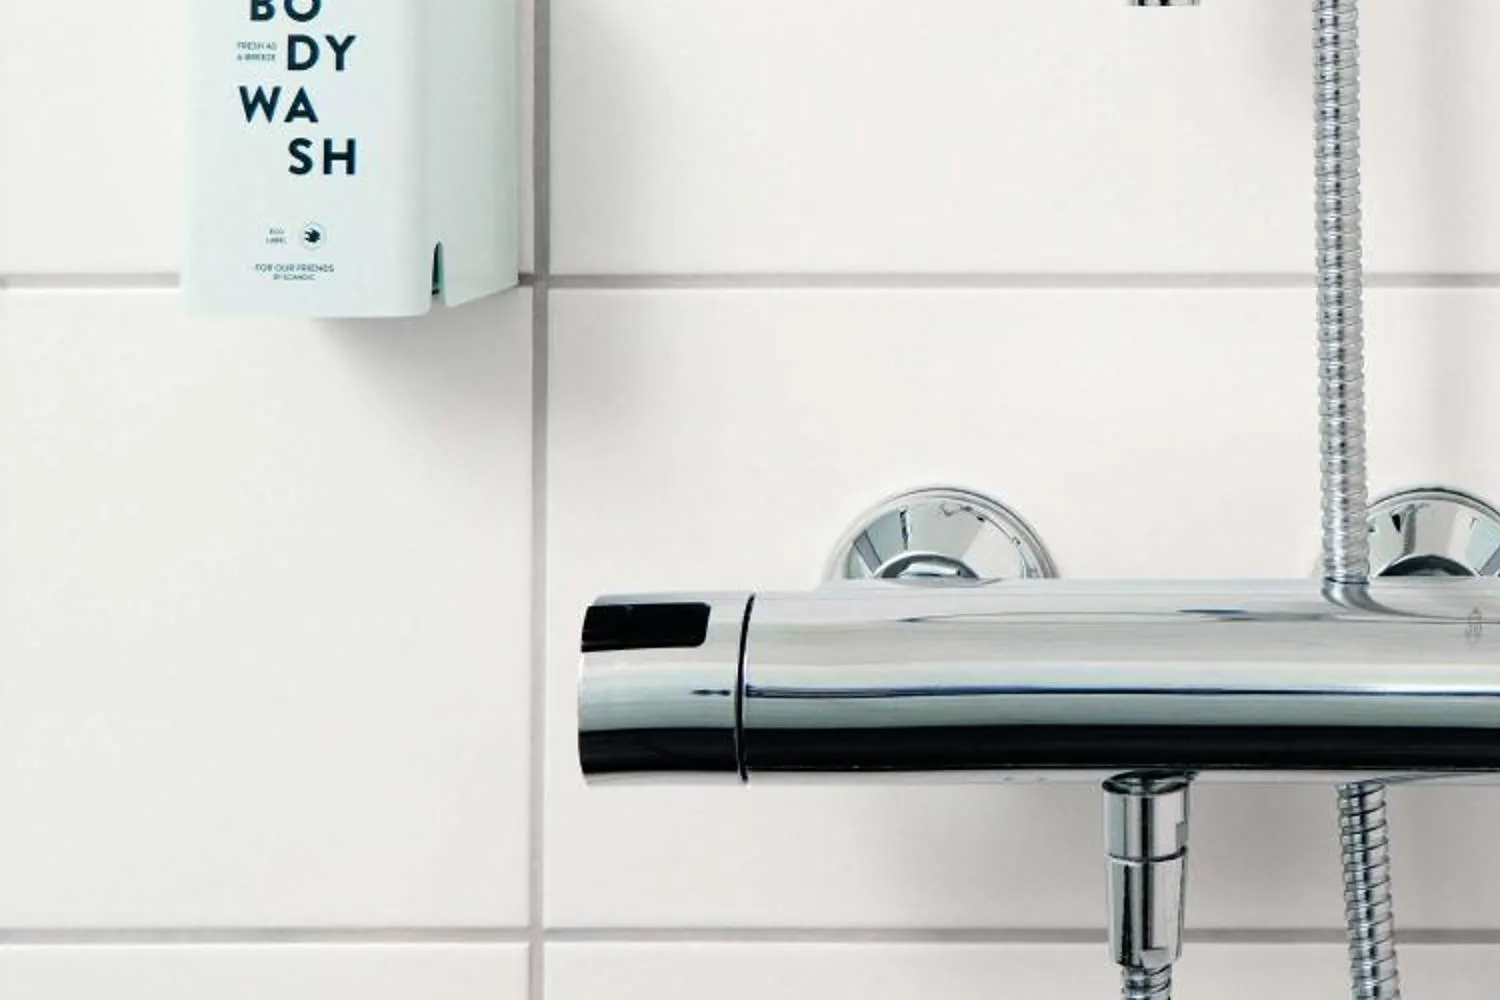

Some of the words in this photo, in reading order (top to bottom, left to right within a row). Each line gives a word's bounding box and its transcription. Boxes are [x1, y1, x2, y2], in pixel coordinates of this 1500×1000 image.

[286, 33, 357, 72] DY
[238, 85, 319, 124] WA
[287, 137, 357, 176] SH
